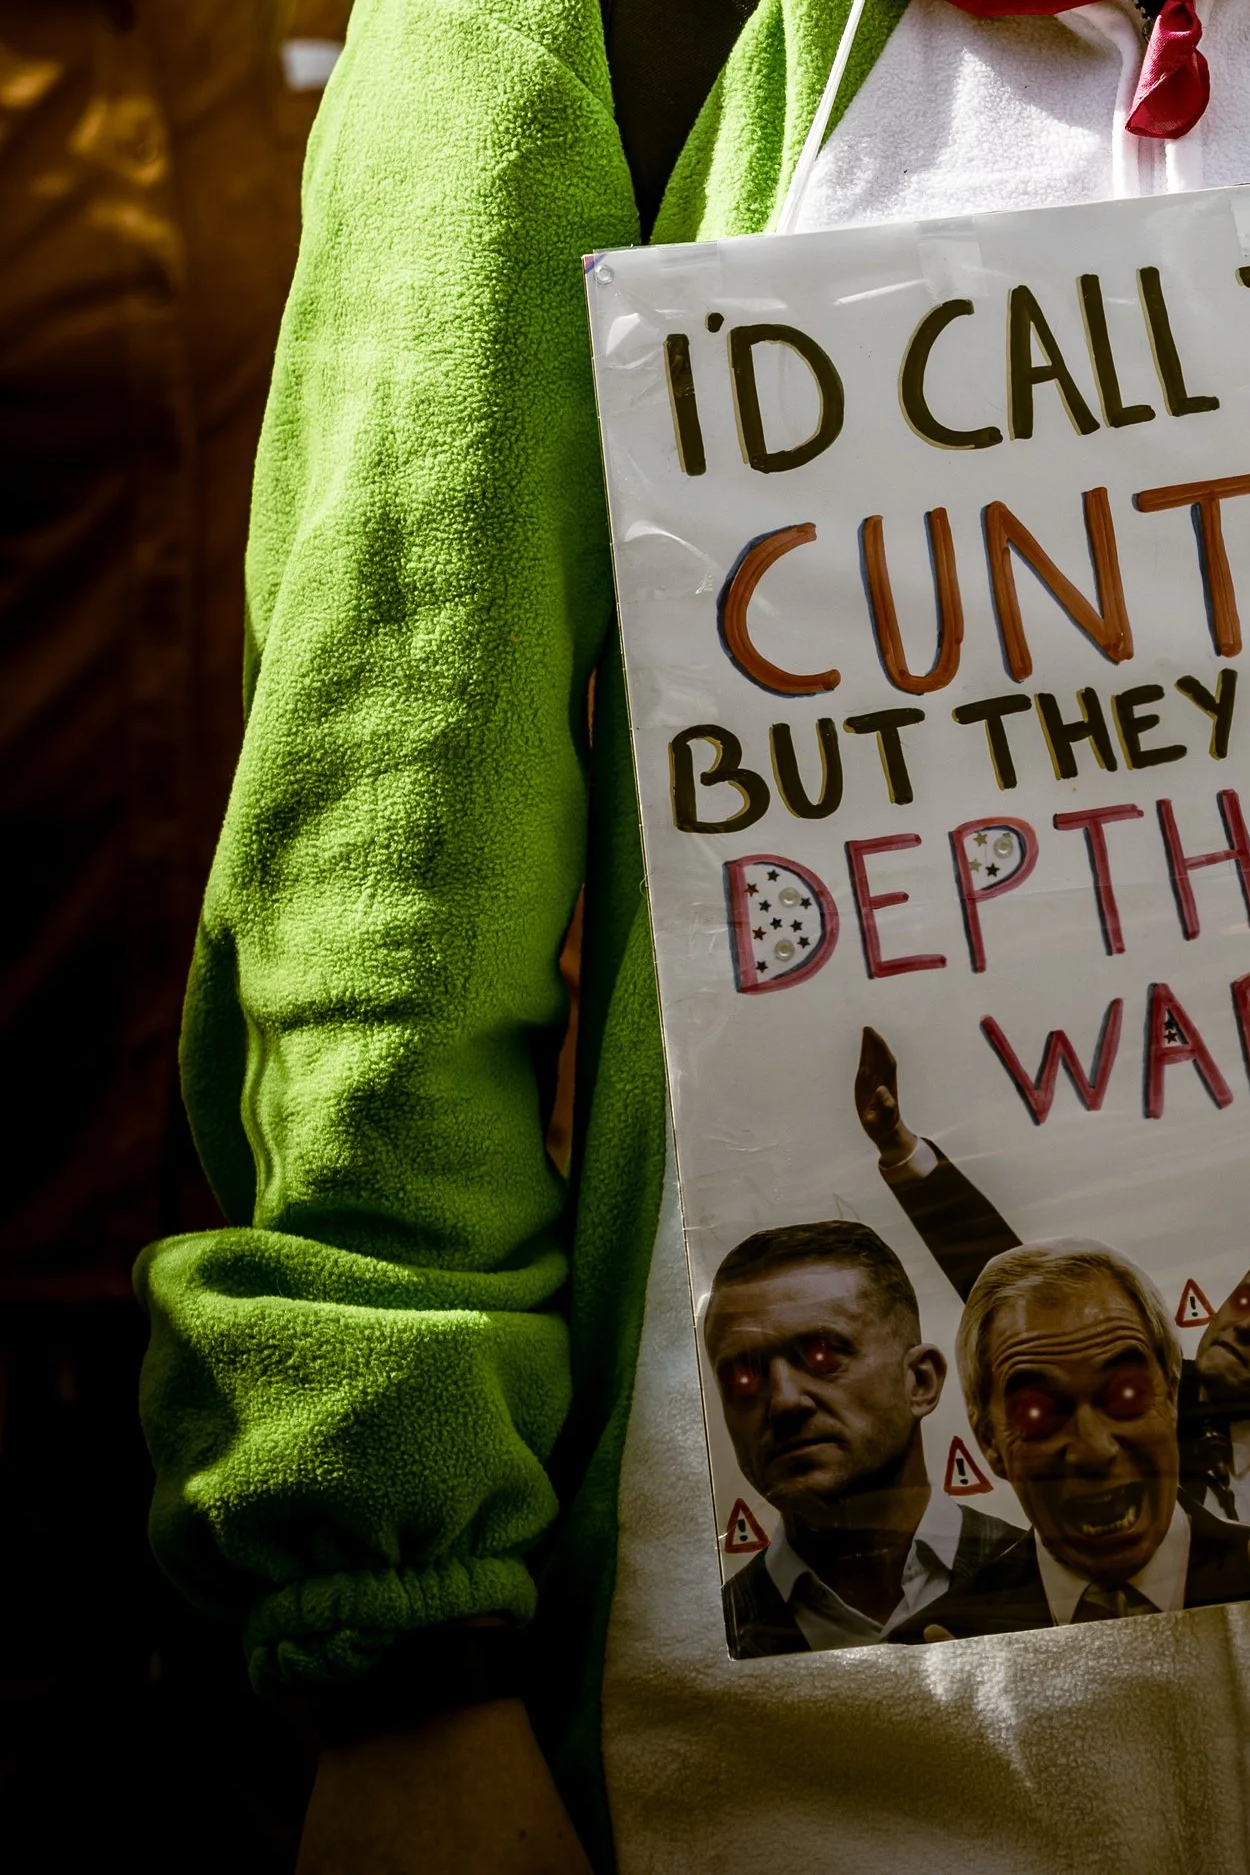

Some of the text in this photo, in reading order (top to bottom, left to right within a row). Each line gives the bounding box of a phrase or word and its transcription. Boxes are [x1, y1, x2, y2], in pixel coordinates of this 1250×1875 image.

[662, 313, 844, 476] I'D
[898, 266, 1220, 450] CALL
[668, 706, 925, 835] BUT
[953, 667, 1238, 790] THEY
